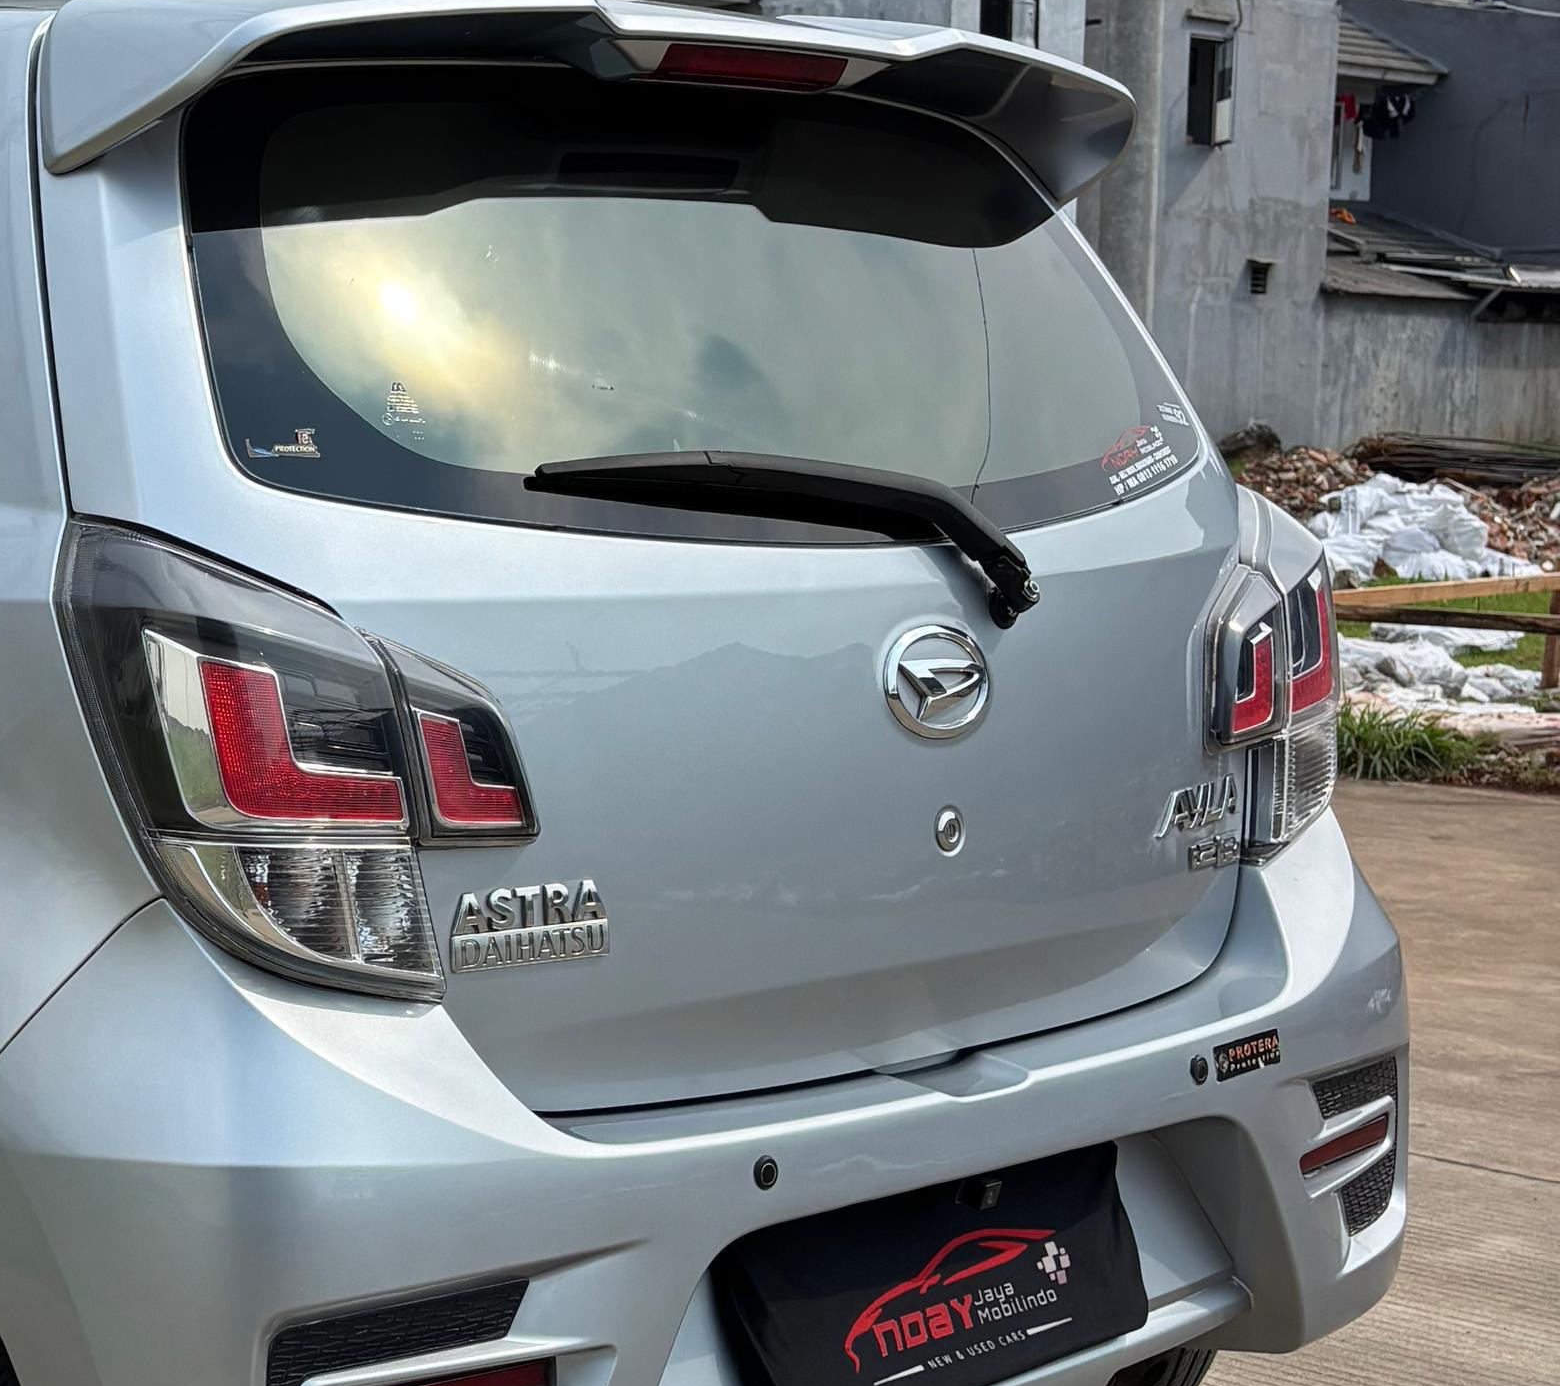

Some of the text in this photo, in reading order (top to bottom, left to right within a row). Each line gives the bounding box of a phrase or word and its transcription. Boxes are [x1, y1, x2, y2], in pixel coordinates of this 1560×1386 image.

[1153, 773, 1238, 838] AYLA
[451, 879, 608, 936] ASTRA
[459, 922, 605, 968] DAIHATSU
[1228, 1035, 1279, 1062] PROTERA
[974, 1282, 1014, 1306] Jaya
[977, 1288, 1058, 1325] Mobilindo
[928, 1330, 1026, 1370] NEW & USED CARS
